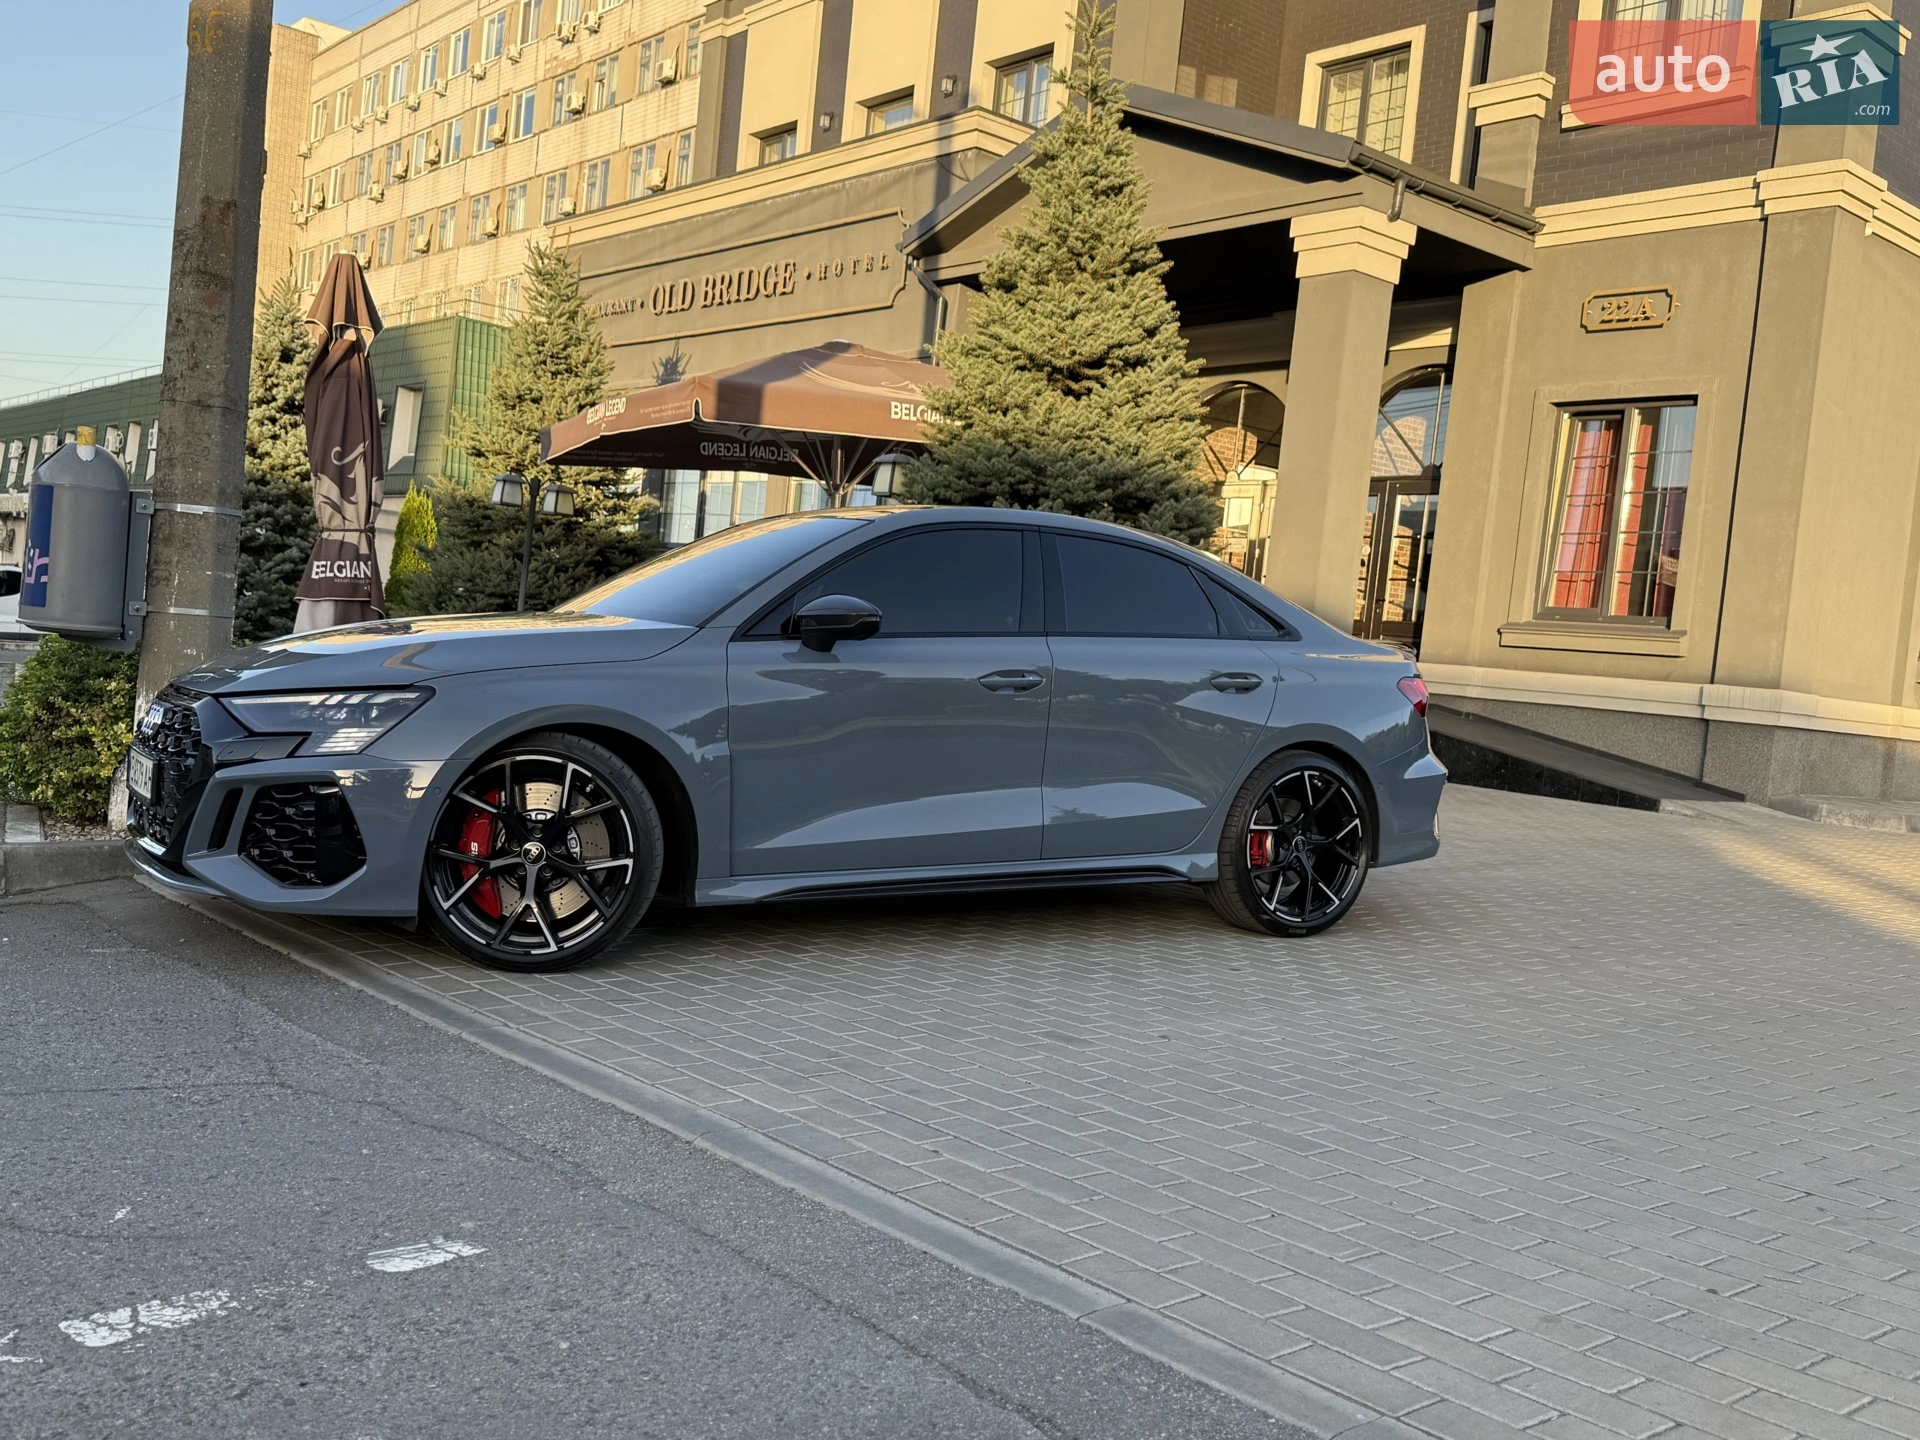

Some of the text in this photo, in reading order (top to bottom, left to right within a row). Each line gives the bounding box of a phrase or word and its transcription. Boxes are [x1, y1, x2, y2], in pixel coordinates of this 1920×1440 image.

[649, 278, 695, 316] OLD
[701, 258, 797, 308] BRIDGE
[817, 251, 891, 281] HOTEL
[1600, 296, 1655, 322] 22A
[606, 397, 627, 417] LEGEND
[890, 401, 951, 425] BELGIA
